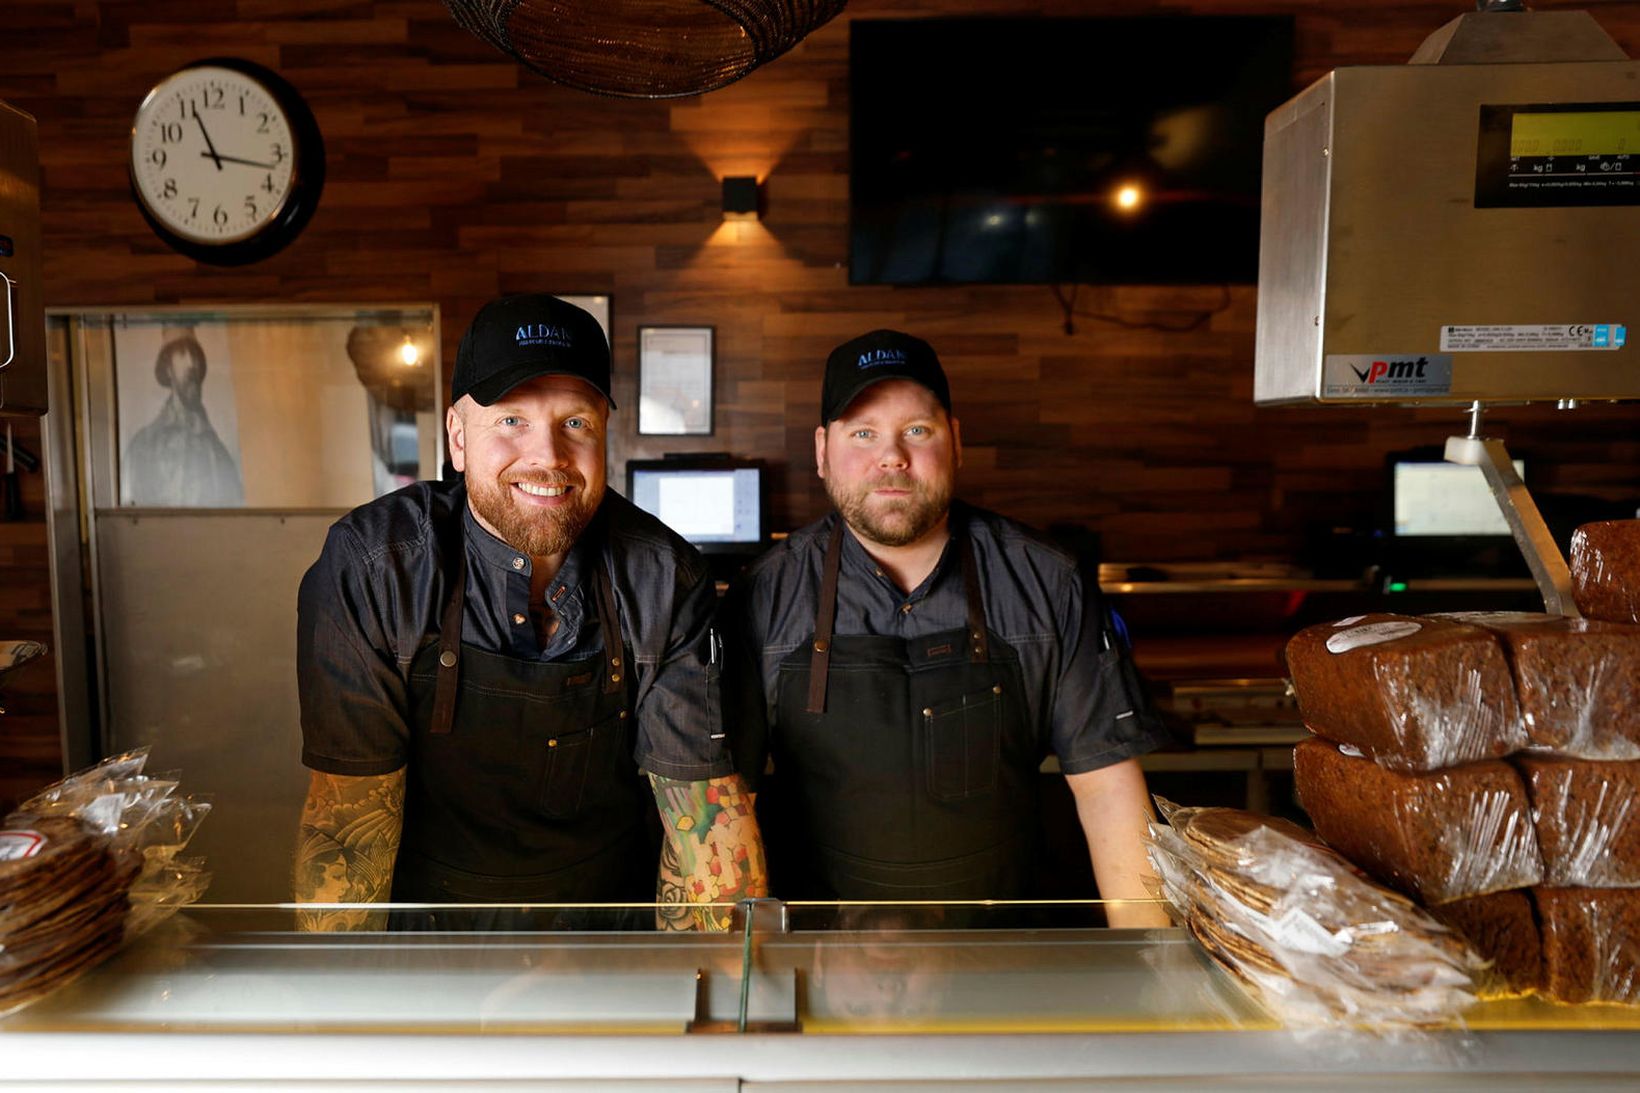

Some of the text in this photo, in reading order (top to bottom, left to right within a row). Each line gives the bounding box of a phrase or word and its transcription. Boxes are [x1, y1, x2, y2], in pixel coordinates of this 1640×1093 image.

[180, 99, 197, 120] 11
[202, 88, 225, 110] 12
[239, 96, 246, 116] 1
[161, 123, 183, 144] 10
[256, 113, 270, 134] 2
[152, 150, 167, 170] 9
[271, 143, 283, 164] 3
[163, 178, 178, 200] 8
[261, 173, 274, 194] 4
[188, 198, 200, 218] 7
[213, 205, 228, 226] 6
[245, 195, 258, 222] 5
[1368, 356, 1429, 384] pmt
